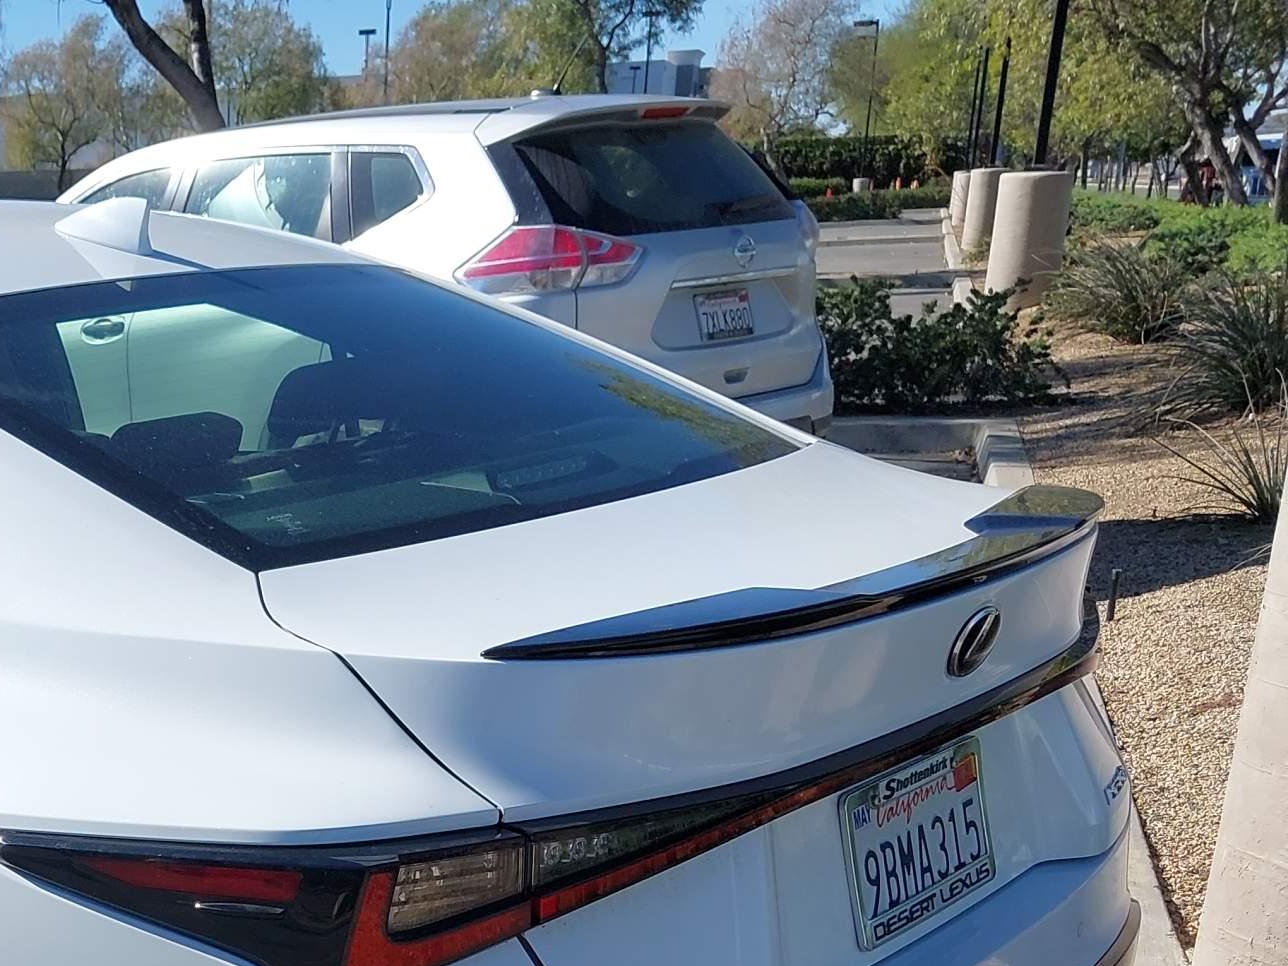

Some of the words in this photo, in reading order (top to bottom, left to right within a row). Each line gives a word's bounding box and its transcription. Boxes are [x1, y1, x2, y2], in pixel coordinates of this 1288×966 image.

[883, 755, 948, 801] Shottenkirk
[853, 803, 871, 830] MAY
[864, 798, 982, 920] 9BMA315
[873, 893, 937, 942] DESERT
[939, 862, 990, 904] LEXUS
